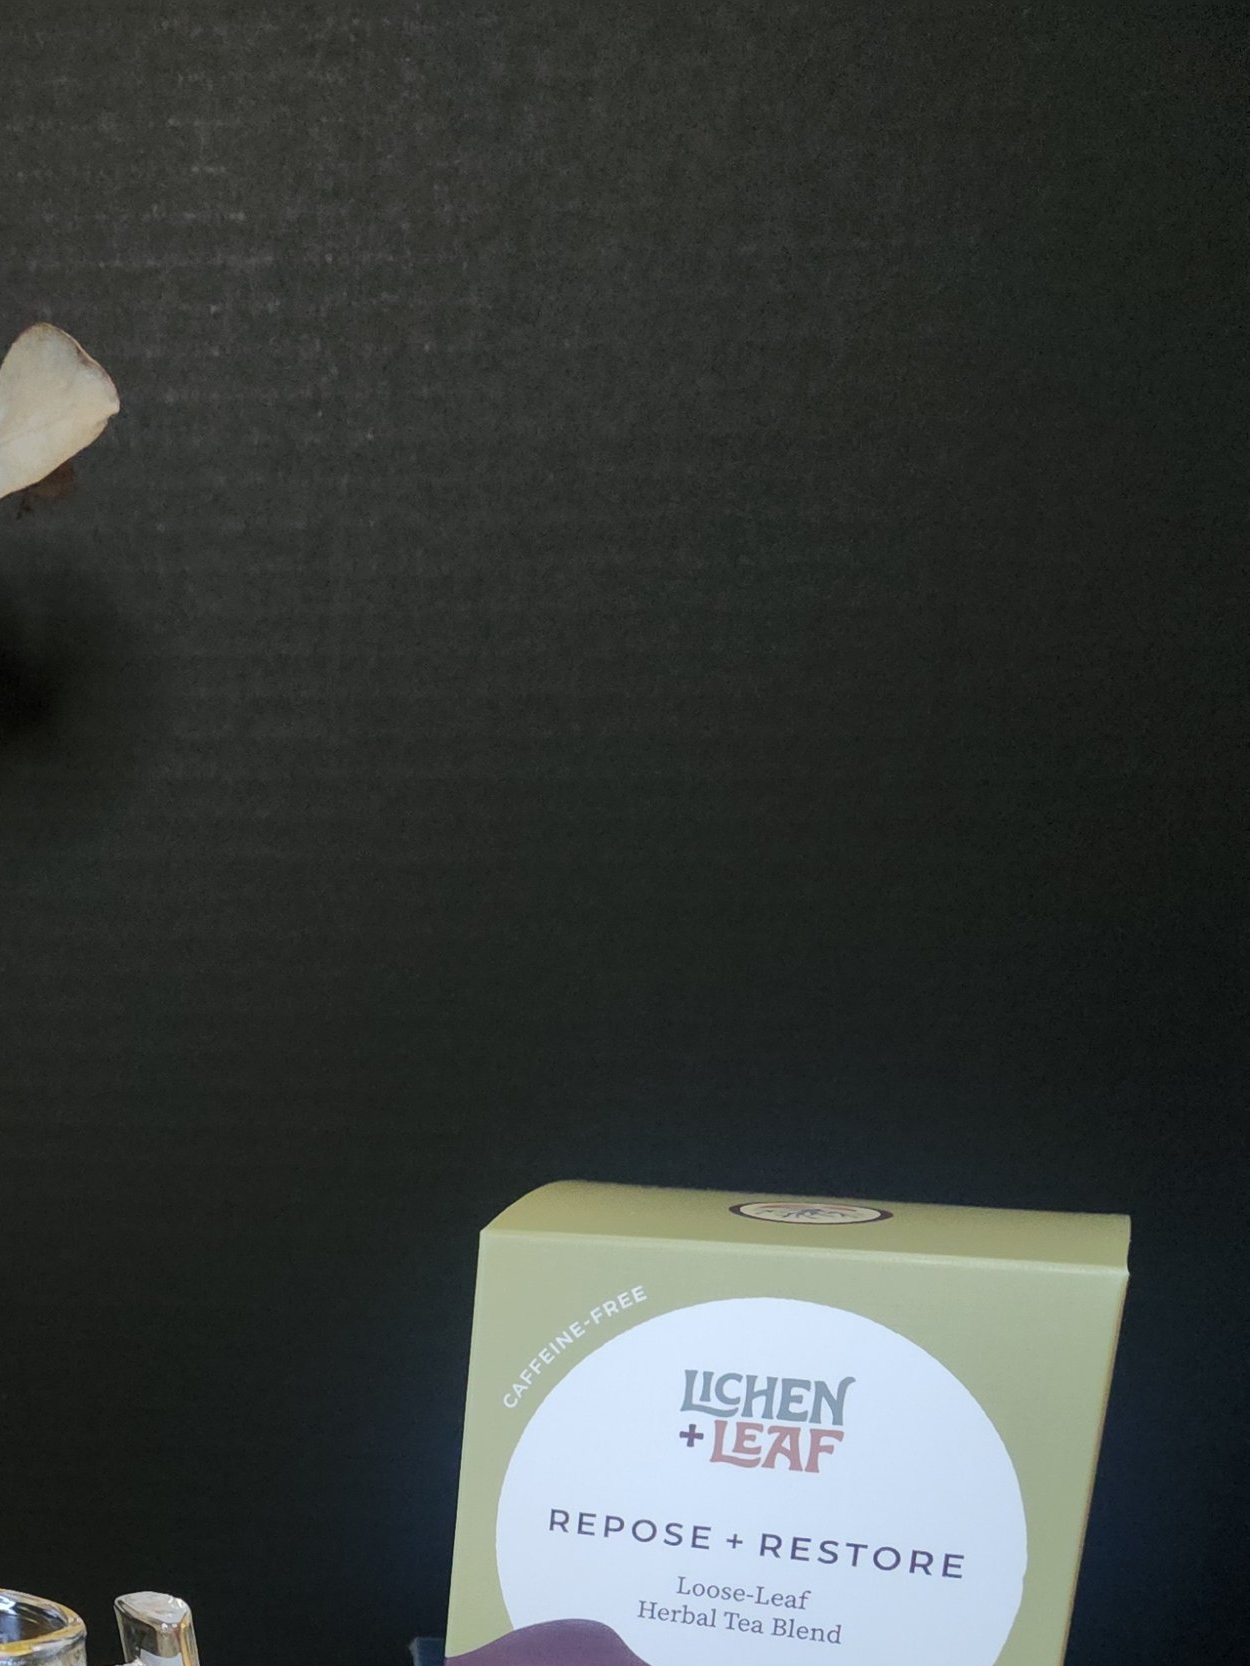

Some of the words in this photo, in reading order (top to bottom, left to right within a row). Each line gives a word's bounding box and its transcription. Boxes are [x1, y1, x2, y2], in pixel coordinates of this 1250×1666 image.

[503, 1285, 647, 1408] CAFFEINE-FREE
[680, 1369, 856, 1426] LICHEN
[710, 1419, 845, 1473] LEAF
[548, 1508, 712, 1550] REPOSE
[725, 1532, 744, 1550] +
[759, 1532, 965, 1579] RESTORE
[676, 1576, 811, 1610] Loose-Leaf
[637, 1600, 717, 1629] Herbal
[724, 1612, 764, 1634] Tea
[772, 1617, 842, 1645] Blend
